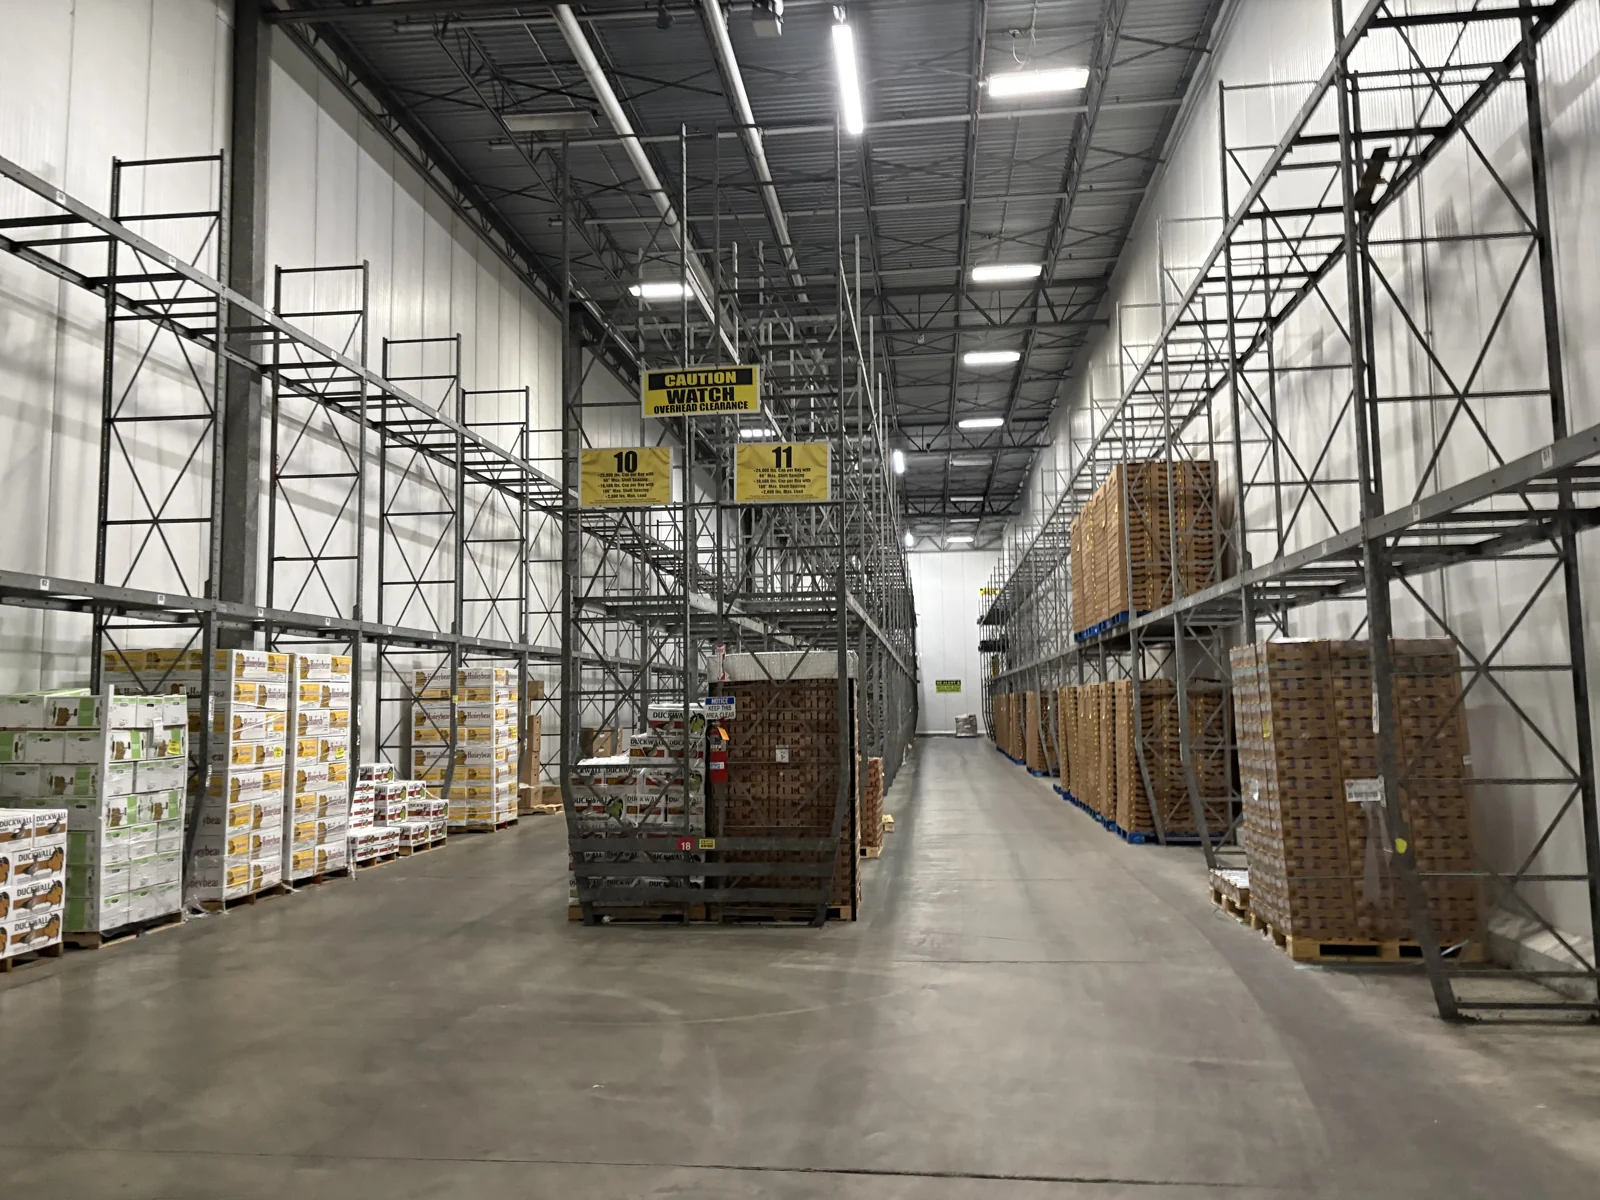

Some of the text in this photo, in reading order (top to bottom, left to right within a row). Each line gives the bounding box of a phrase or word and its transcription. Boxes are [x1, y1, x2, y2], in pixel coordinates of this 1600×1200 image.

[664, 371, 737, 387] CAUTION
[666, 387, 735, 404] WATCH
[654, 401, 748, 414] OVERHEAD CLEARANCE
[614, 450, 638, 473] 10
[772, 446, 792, 468] 11
[36, 812, 66, 822] DUCKWALL
[681, 842, 690, 850] 18
